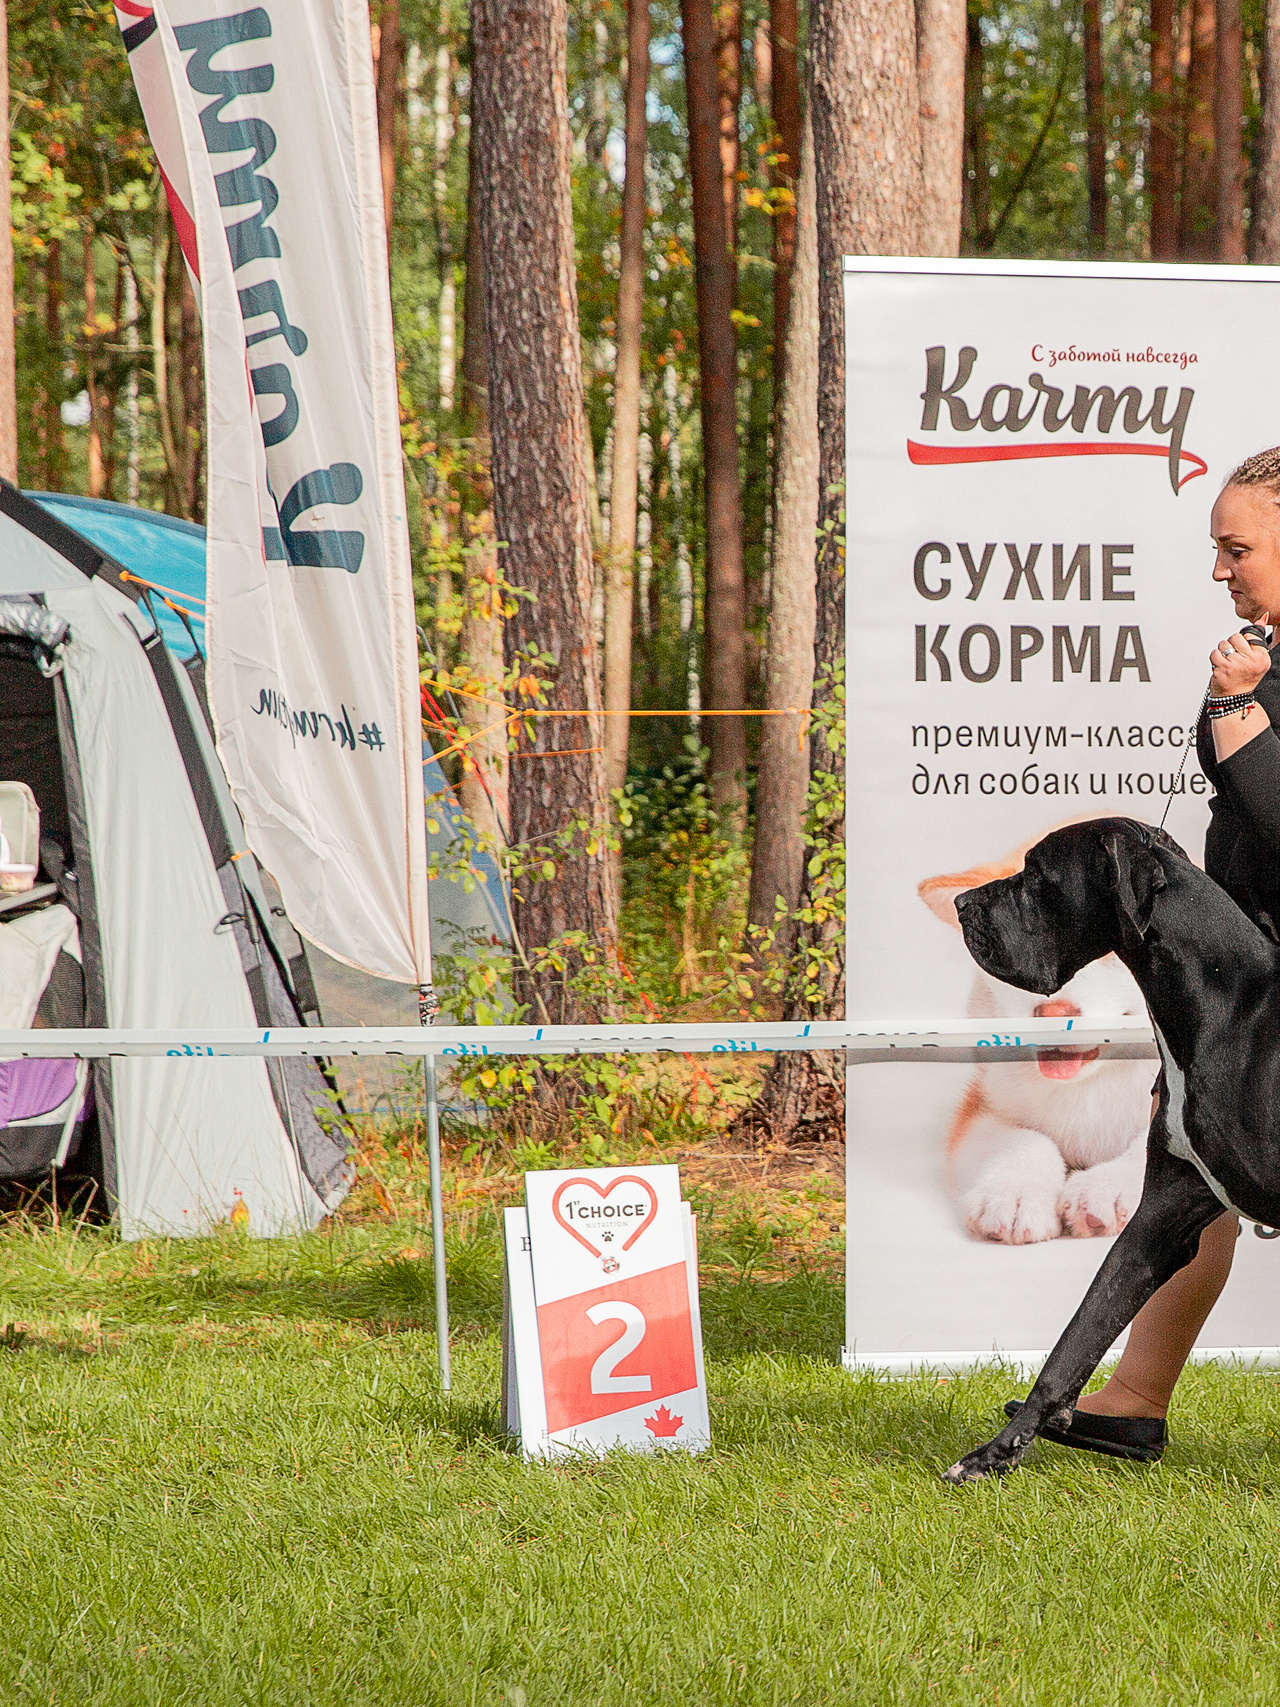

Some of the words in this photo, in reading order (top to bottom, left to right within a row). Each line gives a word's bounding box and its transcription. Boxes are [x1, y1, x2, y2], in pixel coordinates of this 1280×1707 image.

[1031, 343, 1045, 363] С
[1048, 344, 1122, 368] заботой
[1125, 345, 1199, 371] навсегда
[919, 345, 1195, 497] Karmy
[913, 541, 1136, 602] СУХИЕ
[914, 624, 1152, 684] КОРМА
[911, 762, 969, 795] для
[979, 762, 1080, 795] собак
[1089, 773, 1107, 795] и
[577, 1203, 646, 1220] CHOICE
[585, 1299, 653, 1395] 2
